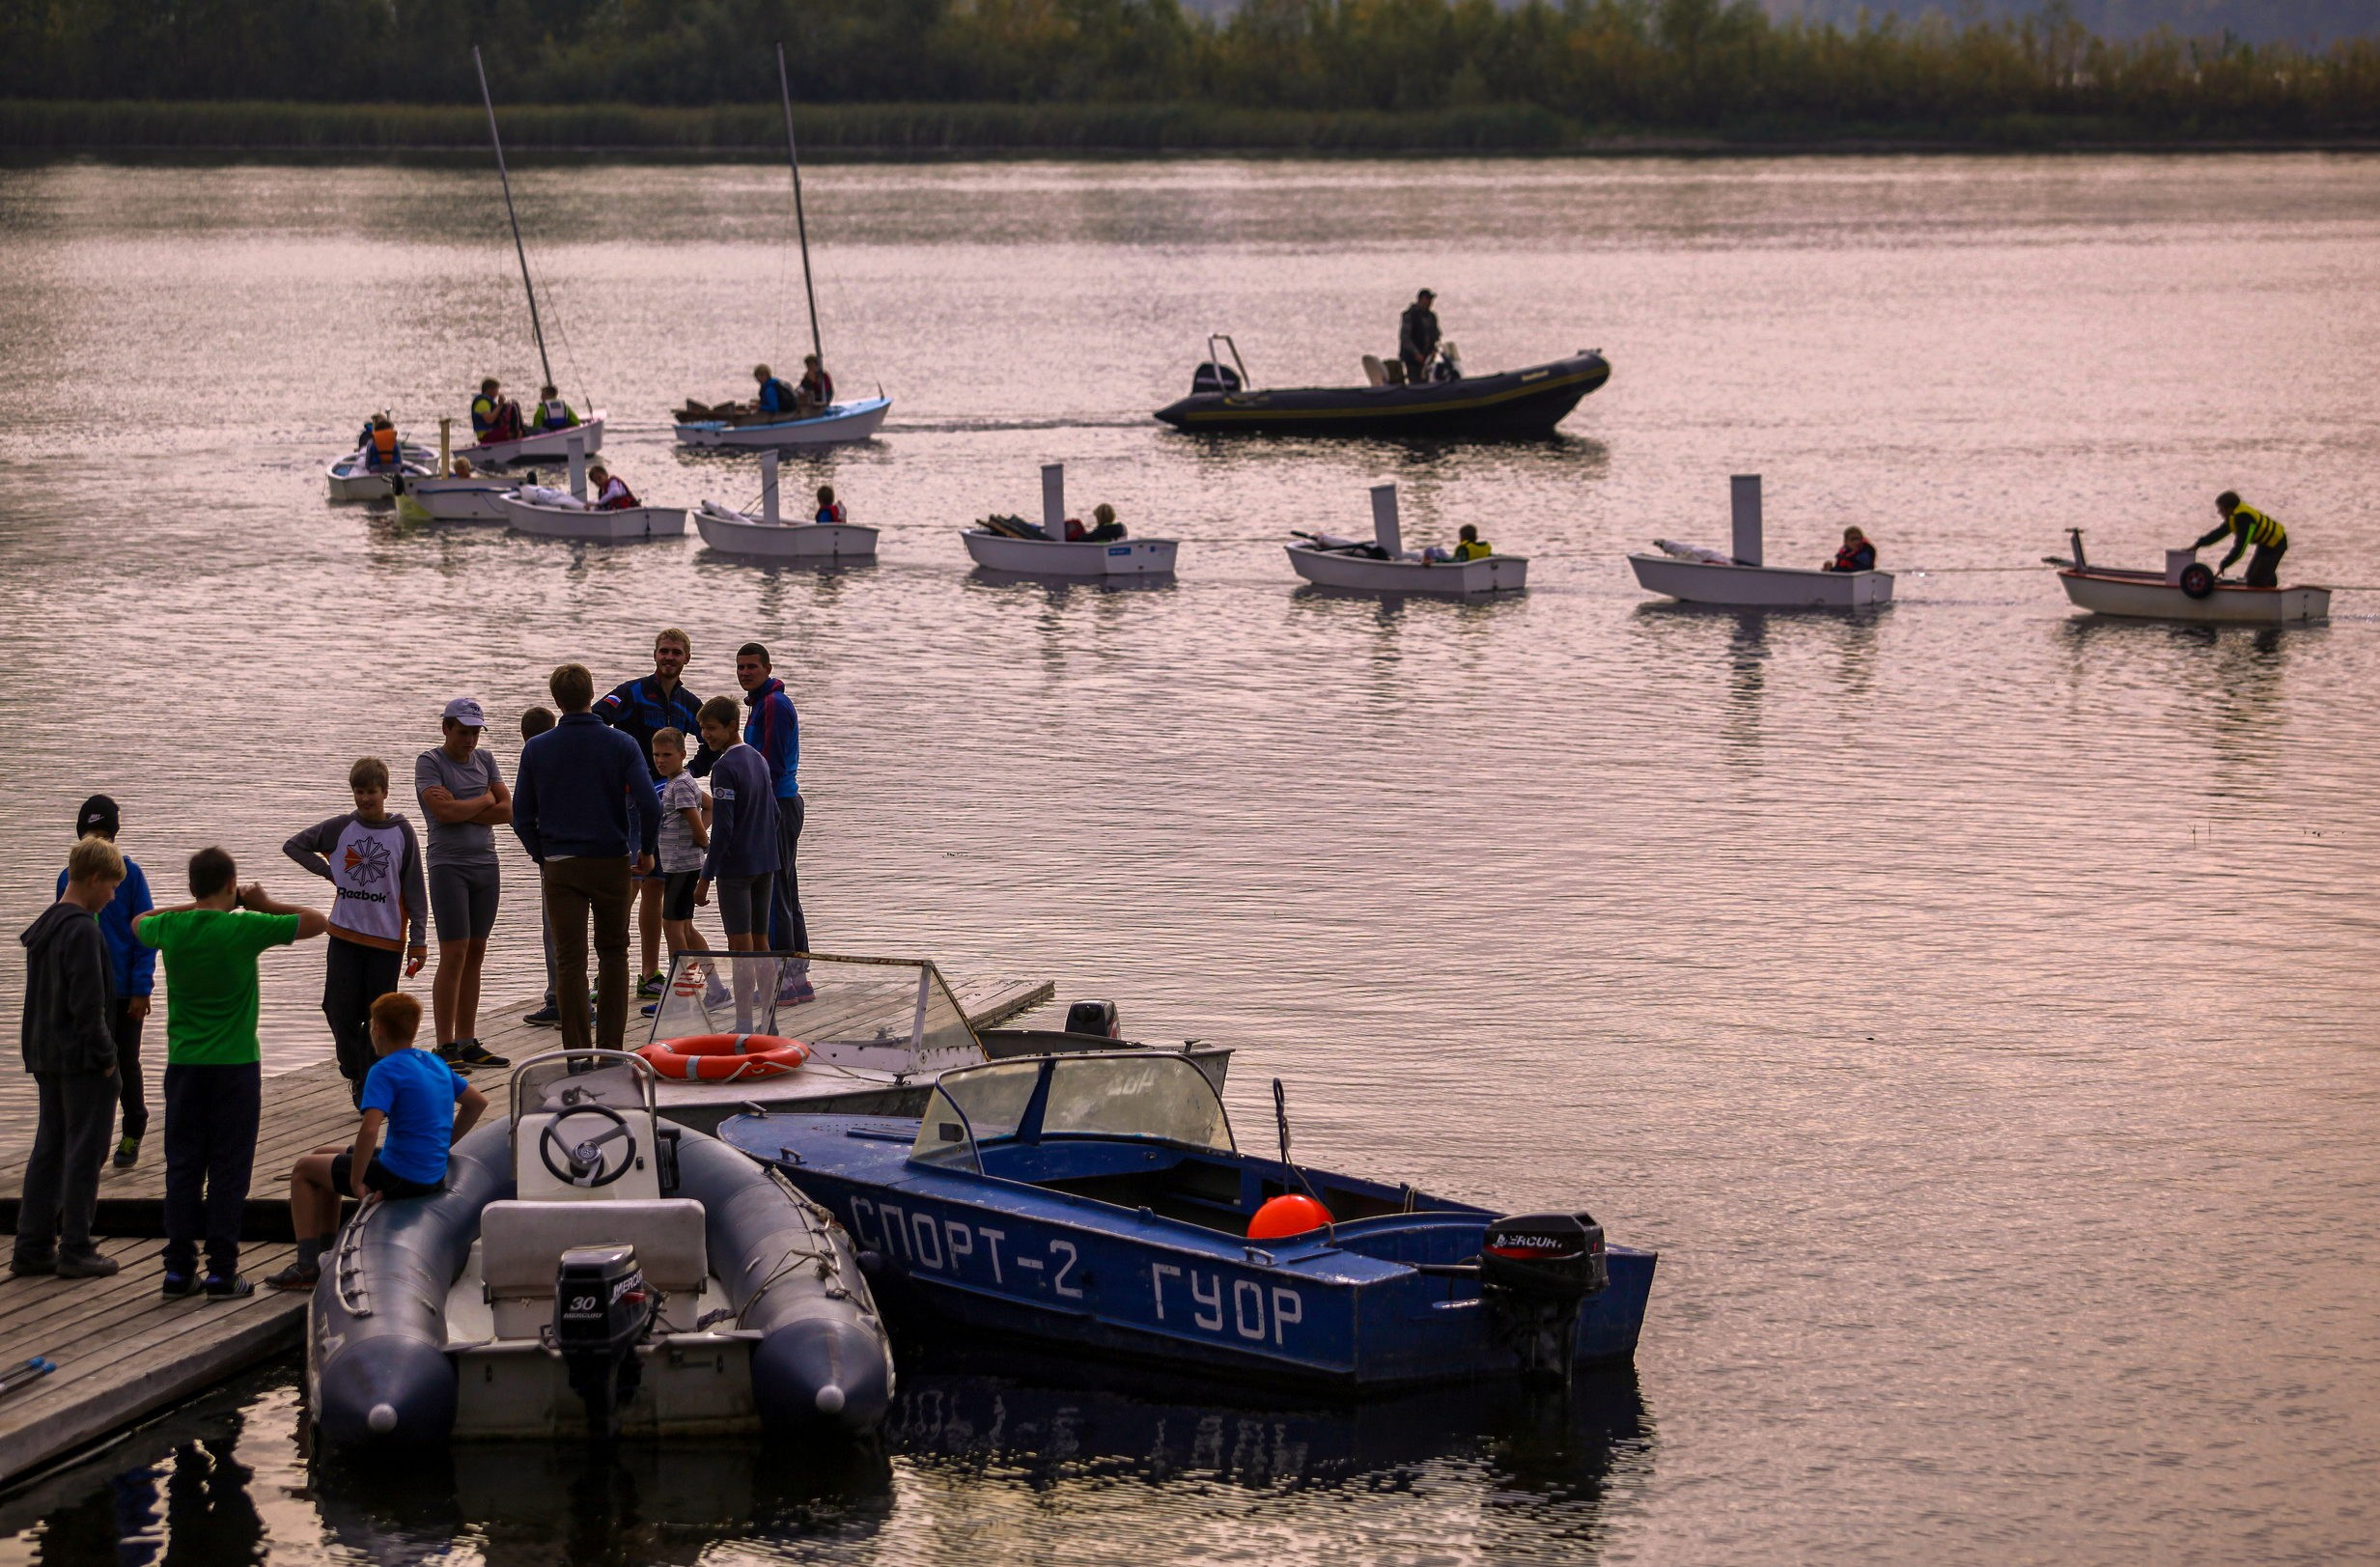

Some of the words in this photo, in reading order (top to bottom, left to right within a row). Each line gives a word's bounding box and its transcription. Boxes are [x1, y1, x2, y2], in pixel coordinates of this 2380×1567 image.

[337, 886, 386, 904] Reebok
[570, 1296, 597, 1311] 30
[1152, 1262, 1302, 1345] ГУОР
